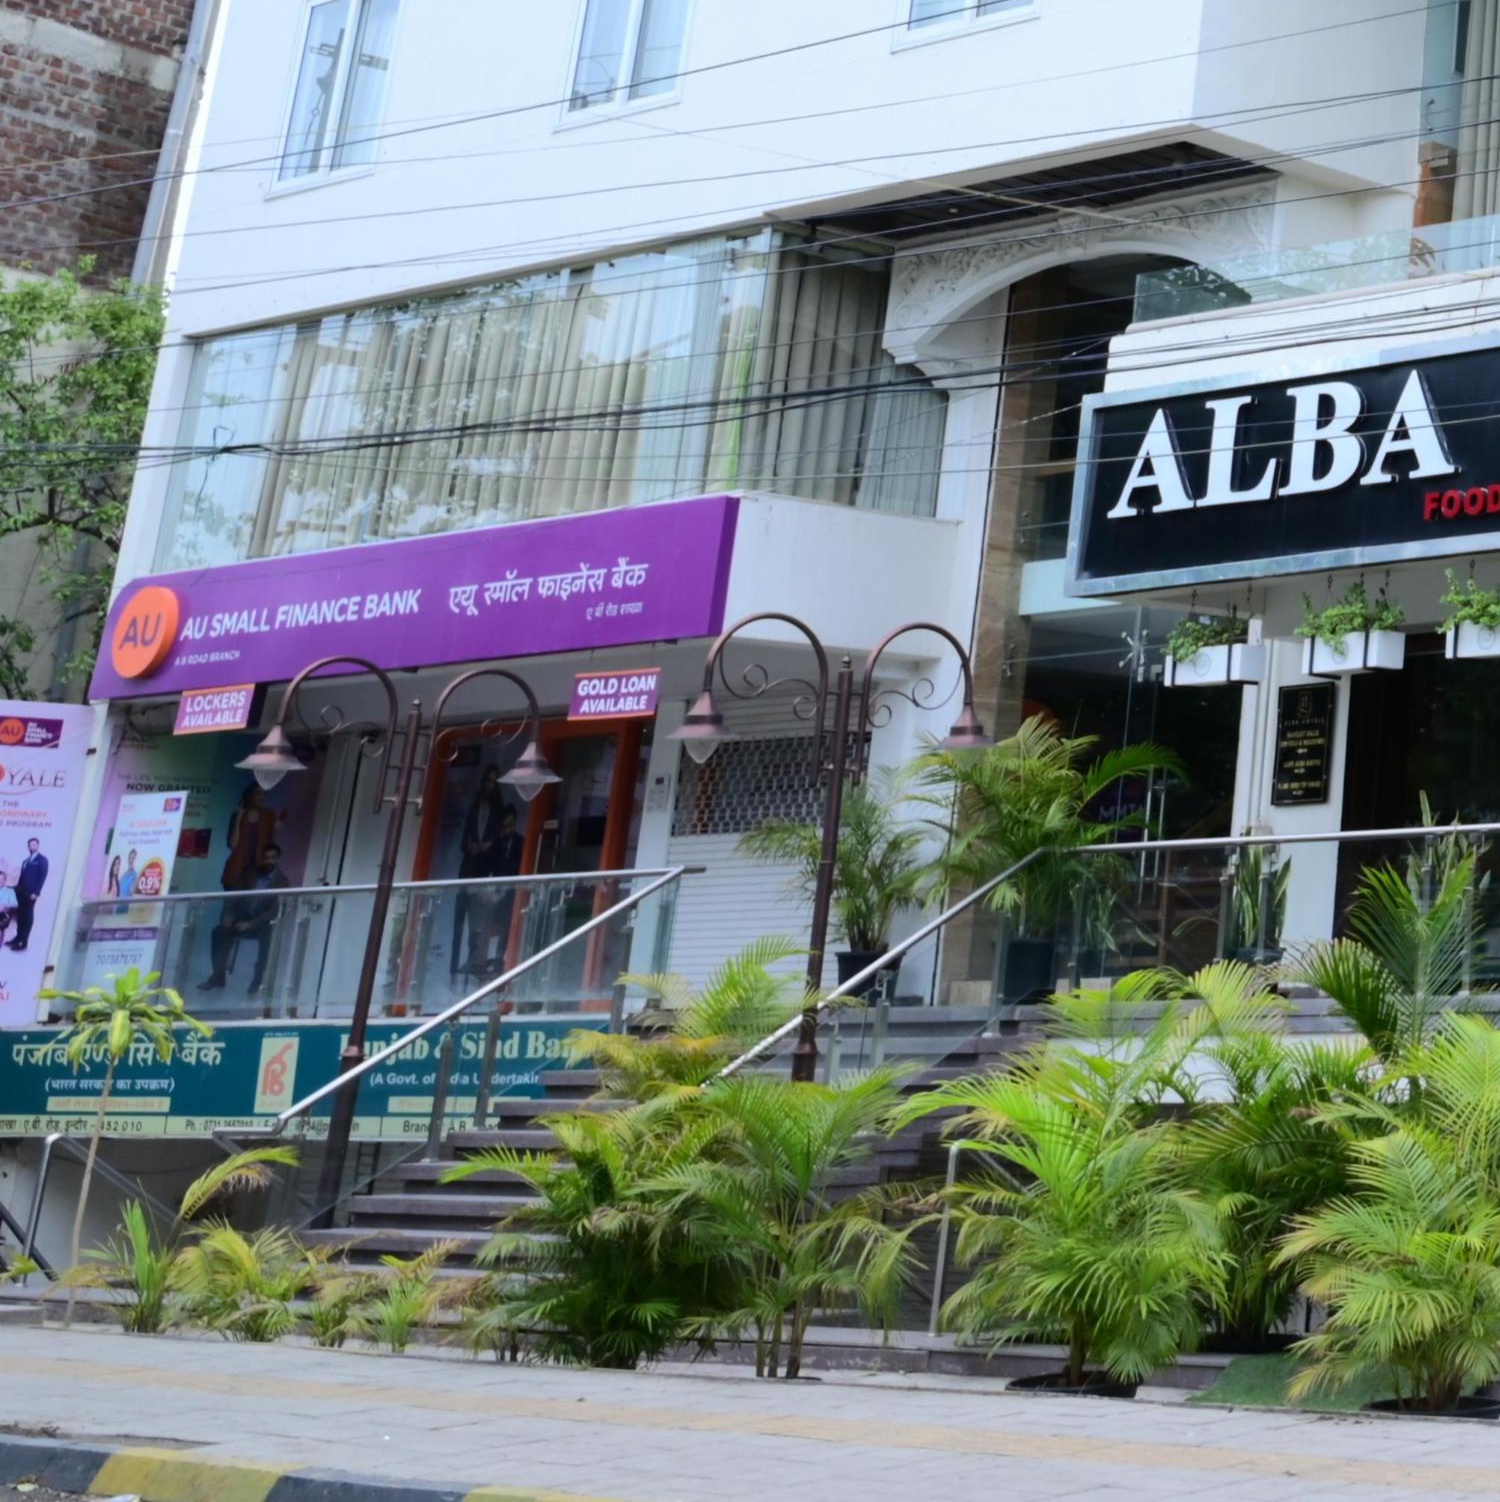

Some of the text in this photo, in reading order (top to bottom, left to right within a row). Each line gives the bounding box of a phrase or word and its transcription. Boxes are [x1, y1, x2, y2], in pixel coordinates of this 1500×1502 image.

[1106, 368, 1457, 519] ALBA
[449, 557, 649, 616] एयू स्मॉल फाइनेंस बैंक
[180, 588, 421, 641] AU SMALL FINANCE BANK
[119, 613, 162, 650] AU
[187, 653, 208, 665] ROAD
[210, 650, 240, 663] BRANCH
[577, 674, 657, 696] GOLD LOAN
[185, 690, 247, 713] LOCKERS
[579, 695, 648, 714] AVAILABLE
[180, 709, 244, 729] AVAILABLE
[1, 766, 67, 789] YALE
[126, 782, 155, 792] NOW
[181, 1032, 226, 1066] बैंक
[116, 1078, 132, 1090] का
[386, 1073, 419, 1085] Govt.
[422, 1072, 436, 1085] of
[474, 1072, 540, 1086] dertaki
[122, 1120, 142, 1132] 010
